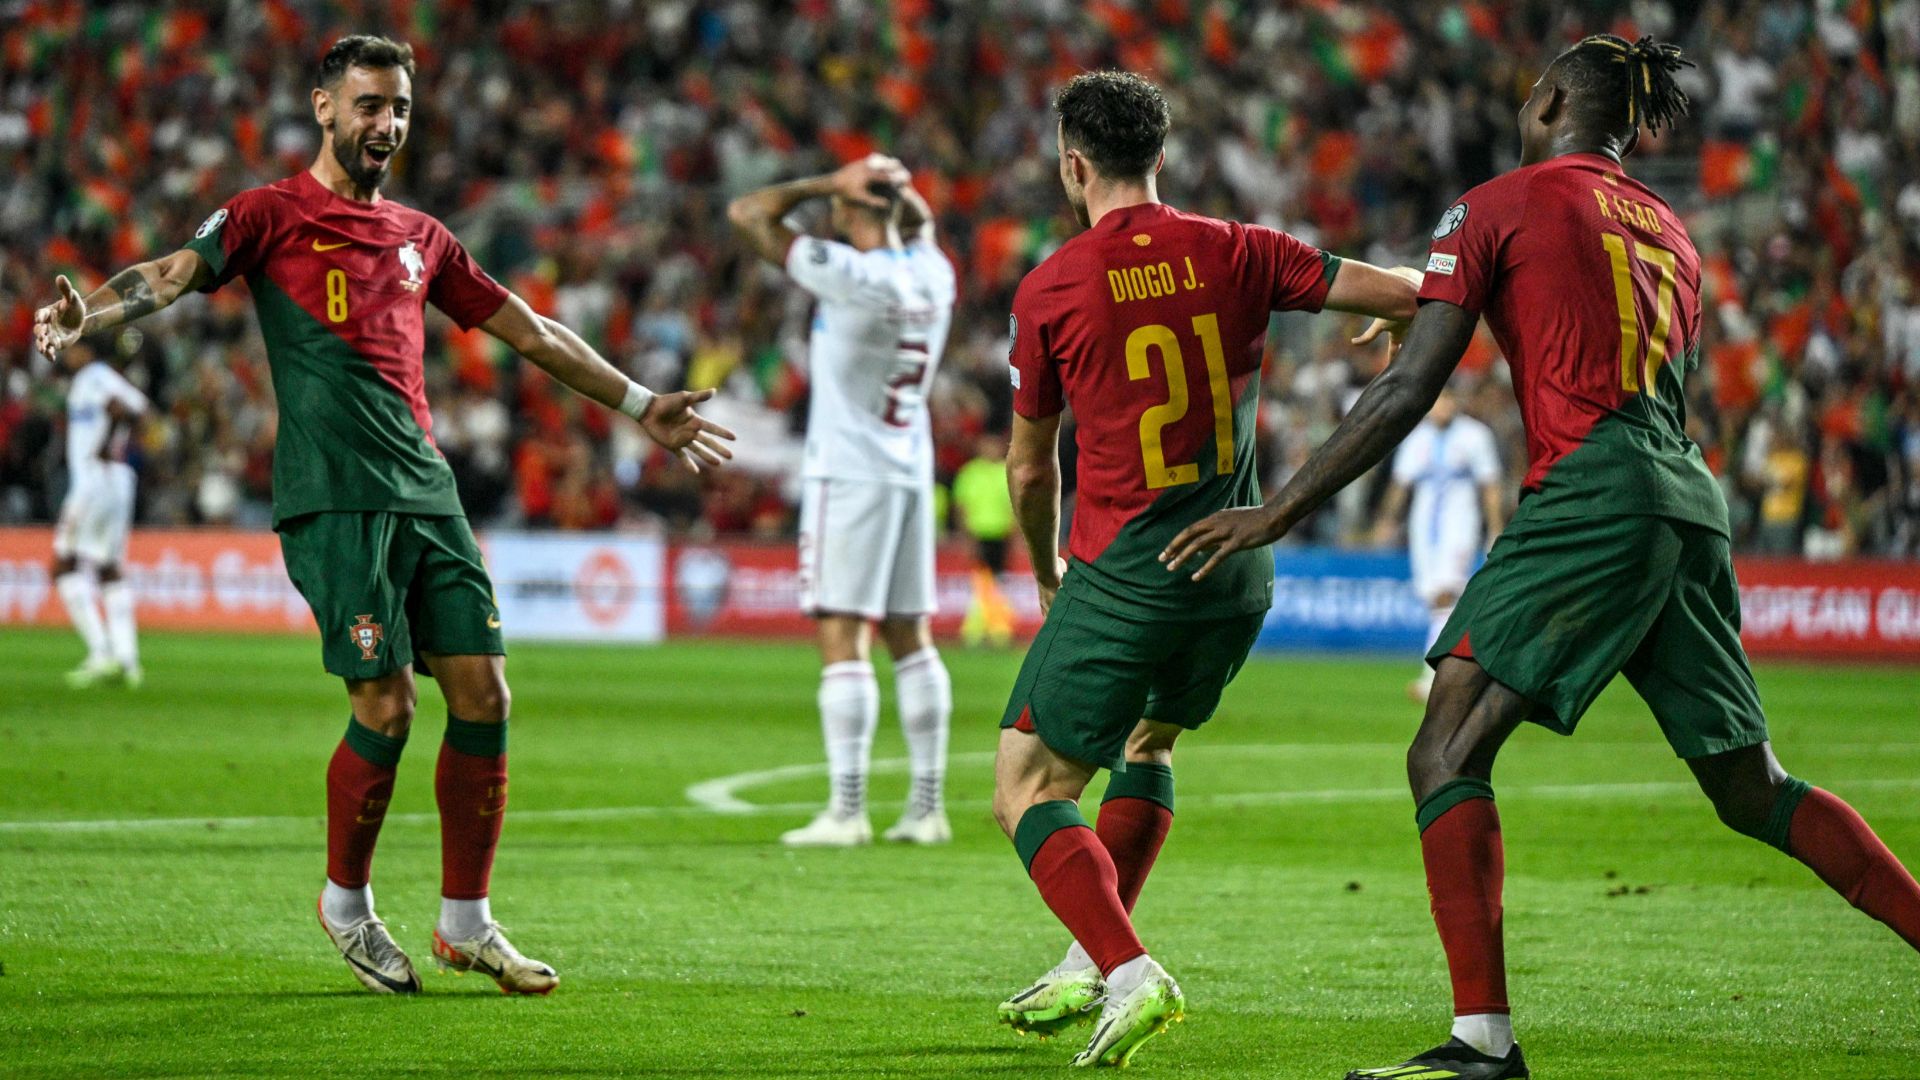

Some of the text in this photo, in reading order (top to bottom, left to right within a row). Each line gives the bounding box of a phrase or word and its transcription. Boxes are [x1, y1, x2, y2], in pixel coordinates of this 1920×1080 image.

[326, 269, 348, 323] 8
[1107, 256, 1205, 303] DIOGO J.
[1601, 232, 1676, 398] 17
[1125, 313, 1234, 489] 21
